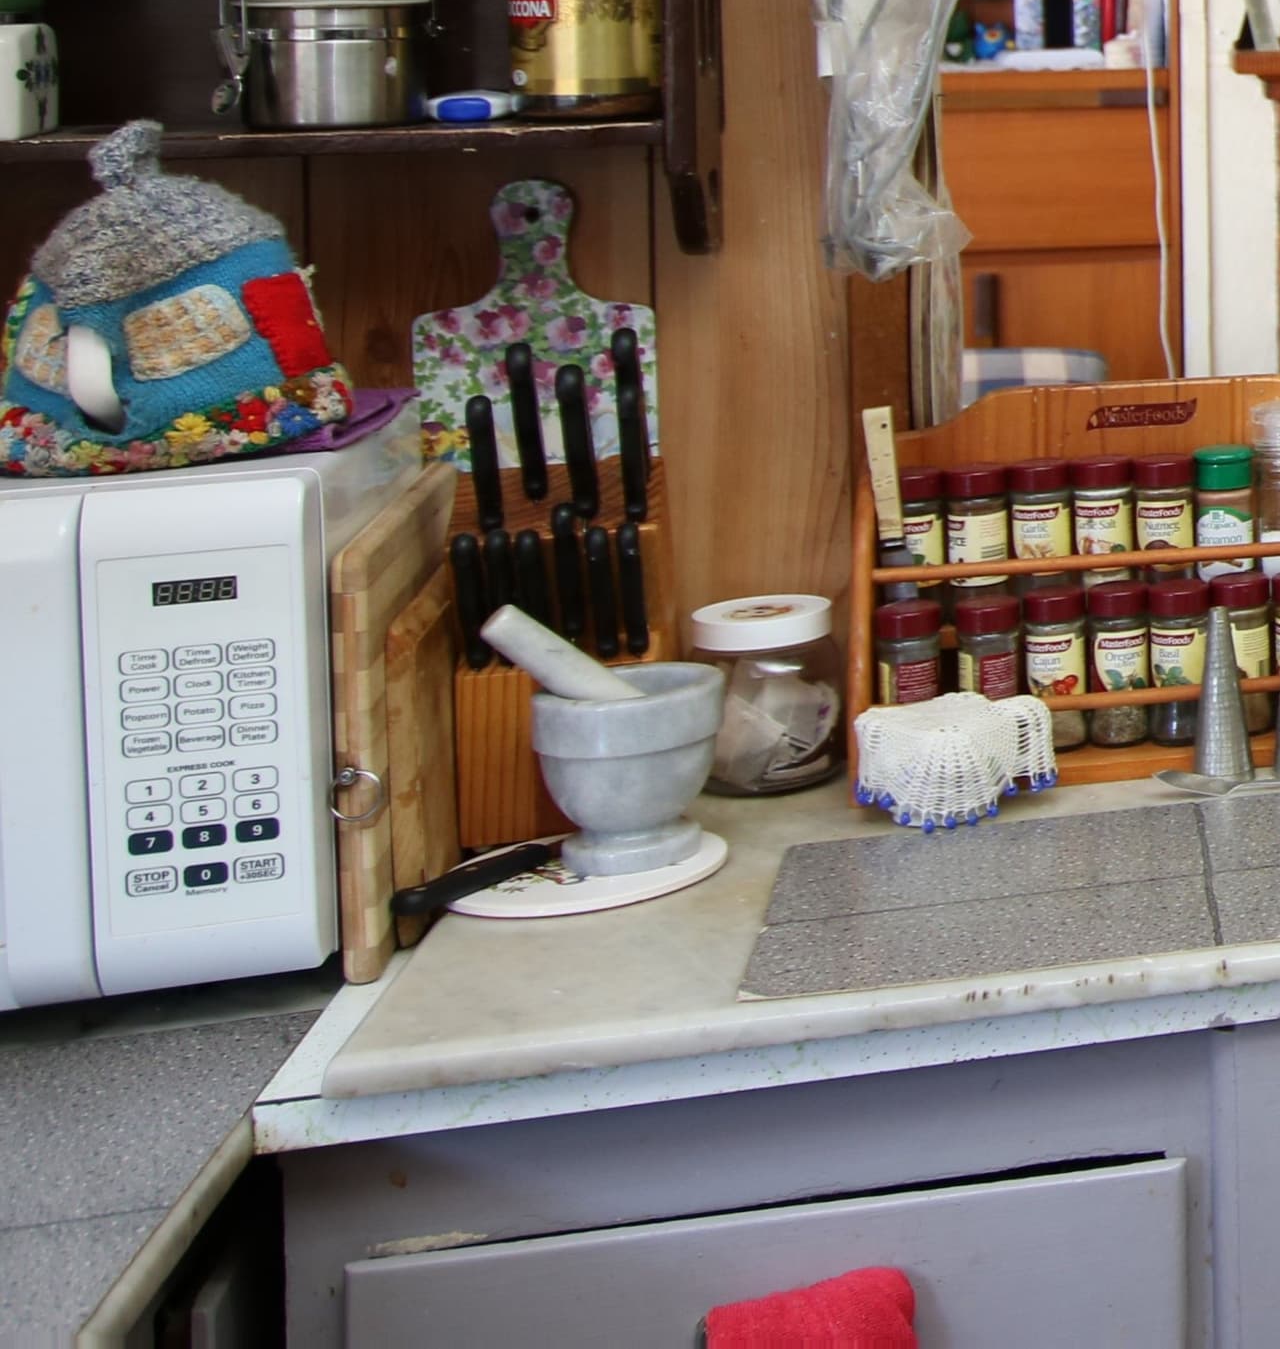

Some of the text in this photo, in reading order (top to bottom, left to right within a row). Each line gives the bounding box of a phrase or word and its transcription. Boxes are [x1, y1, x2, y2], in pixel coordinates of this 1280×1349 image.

[509, 0, 551, 17] CCONA
[1099, 519, 1116, 530] Salt
[1144, 520, 1181, 533] Nutmeg
[185, 649, 211, 657] Time
[231, 642, 269, 653] Weight
[130, 654, 157, 662] Time
[232, 651, 270, 661] Defrost
[1032, 656, 1061, 667] Cajun
[130, 663, 157, 671] Cook
[178, 657, 217, 667] Defrost
[232, 670, 271, 680] Kitchen
[184, 680, 212, 689] Clock
[236, 678, 267, 687] Timer
[128, 685, 161, 694] Power
[183, 706, 217, 716] Potato
[240, 701, 266, 710] Pizza
[124, 712, 168, 722] Popcorn
[236, 724, 271, 734] Dinner
[132, 735, 161, 744] Frozen
[178, 733, 223, 745] Beverage
[241, 732, 267, 741] Plate
[167, 760, 236, 773] EXPRESS COOK
[250, 773, 261, 785] 3
[197, 779, 208, 791] 2
[145, 785, 153, 797] 1
[251, 799, 262, 810] 6
[198, 805, 209, 816] 5
[144, 811, 155, 822] 4
[252, 824, 263, 836] 9
[199, 830, 210, 843] 8
[145, 837, 156, 849] 7
[240, 857, 278, 870] START
[133, 871, 170, 883] STOP
[201, 869, 211, 880] 0
[134, 883, 170, 893] Cancel
[185, 886, 228, 897] Memory
